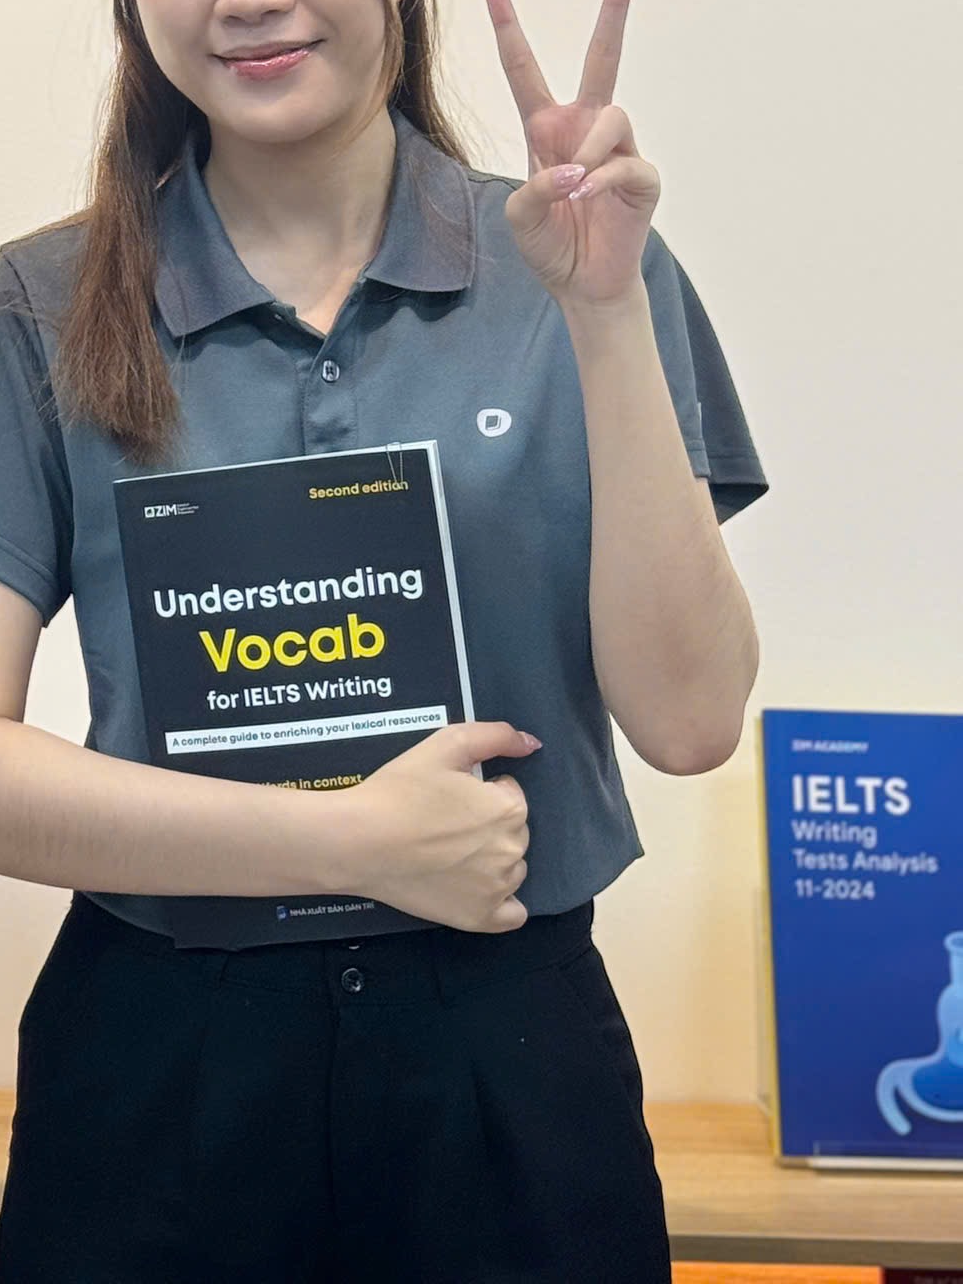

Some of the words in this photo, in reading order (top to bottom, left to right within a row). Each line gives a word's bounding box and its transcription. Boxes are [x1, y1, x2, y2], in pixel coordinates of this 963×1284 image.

[308, 482, 360, 500] Second
[361, 478, 409, 494] edition
[153, 566, 424, 618] Understanding
[199, 613, 386, 673] Vocab
[206, 689, 240, 711] for
[243, 683, 301, 707] IELTS
[304, 676, 393, 704] Writing
[172, 737, 180, 747] A
[181, 733, 229, 748] complete
[229, 730, 259, 744] guide
[260, 730, 272, 740] to
[273, 724, 324, 740] enriching
[325, 722, 350, 736] your
[351, 717, 387, 730] lexical
[388, 712, 441, 727] resources
[299, 778, 312, 790] in
[313, 774, 363, 789] context
[792, 774, 911, 816] IELTS
[791, 819, 878, 850] Writing
[793, 848, 849, 871] Tests
[851, 850, 939, 876] Analysis
[794, 878, 876, 900] 11-2024
